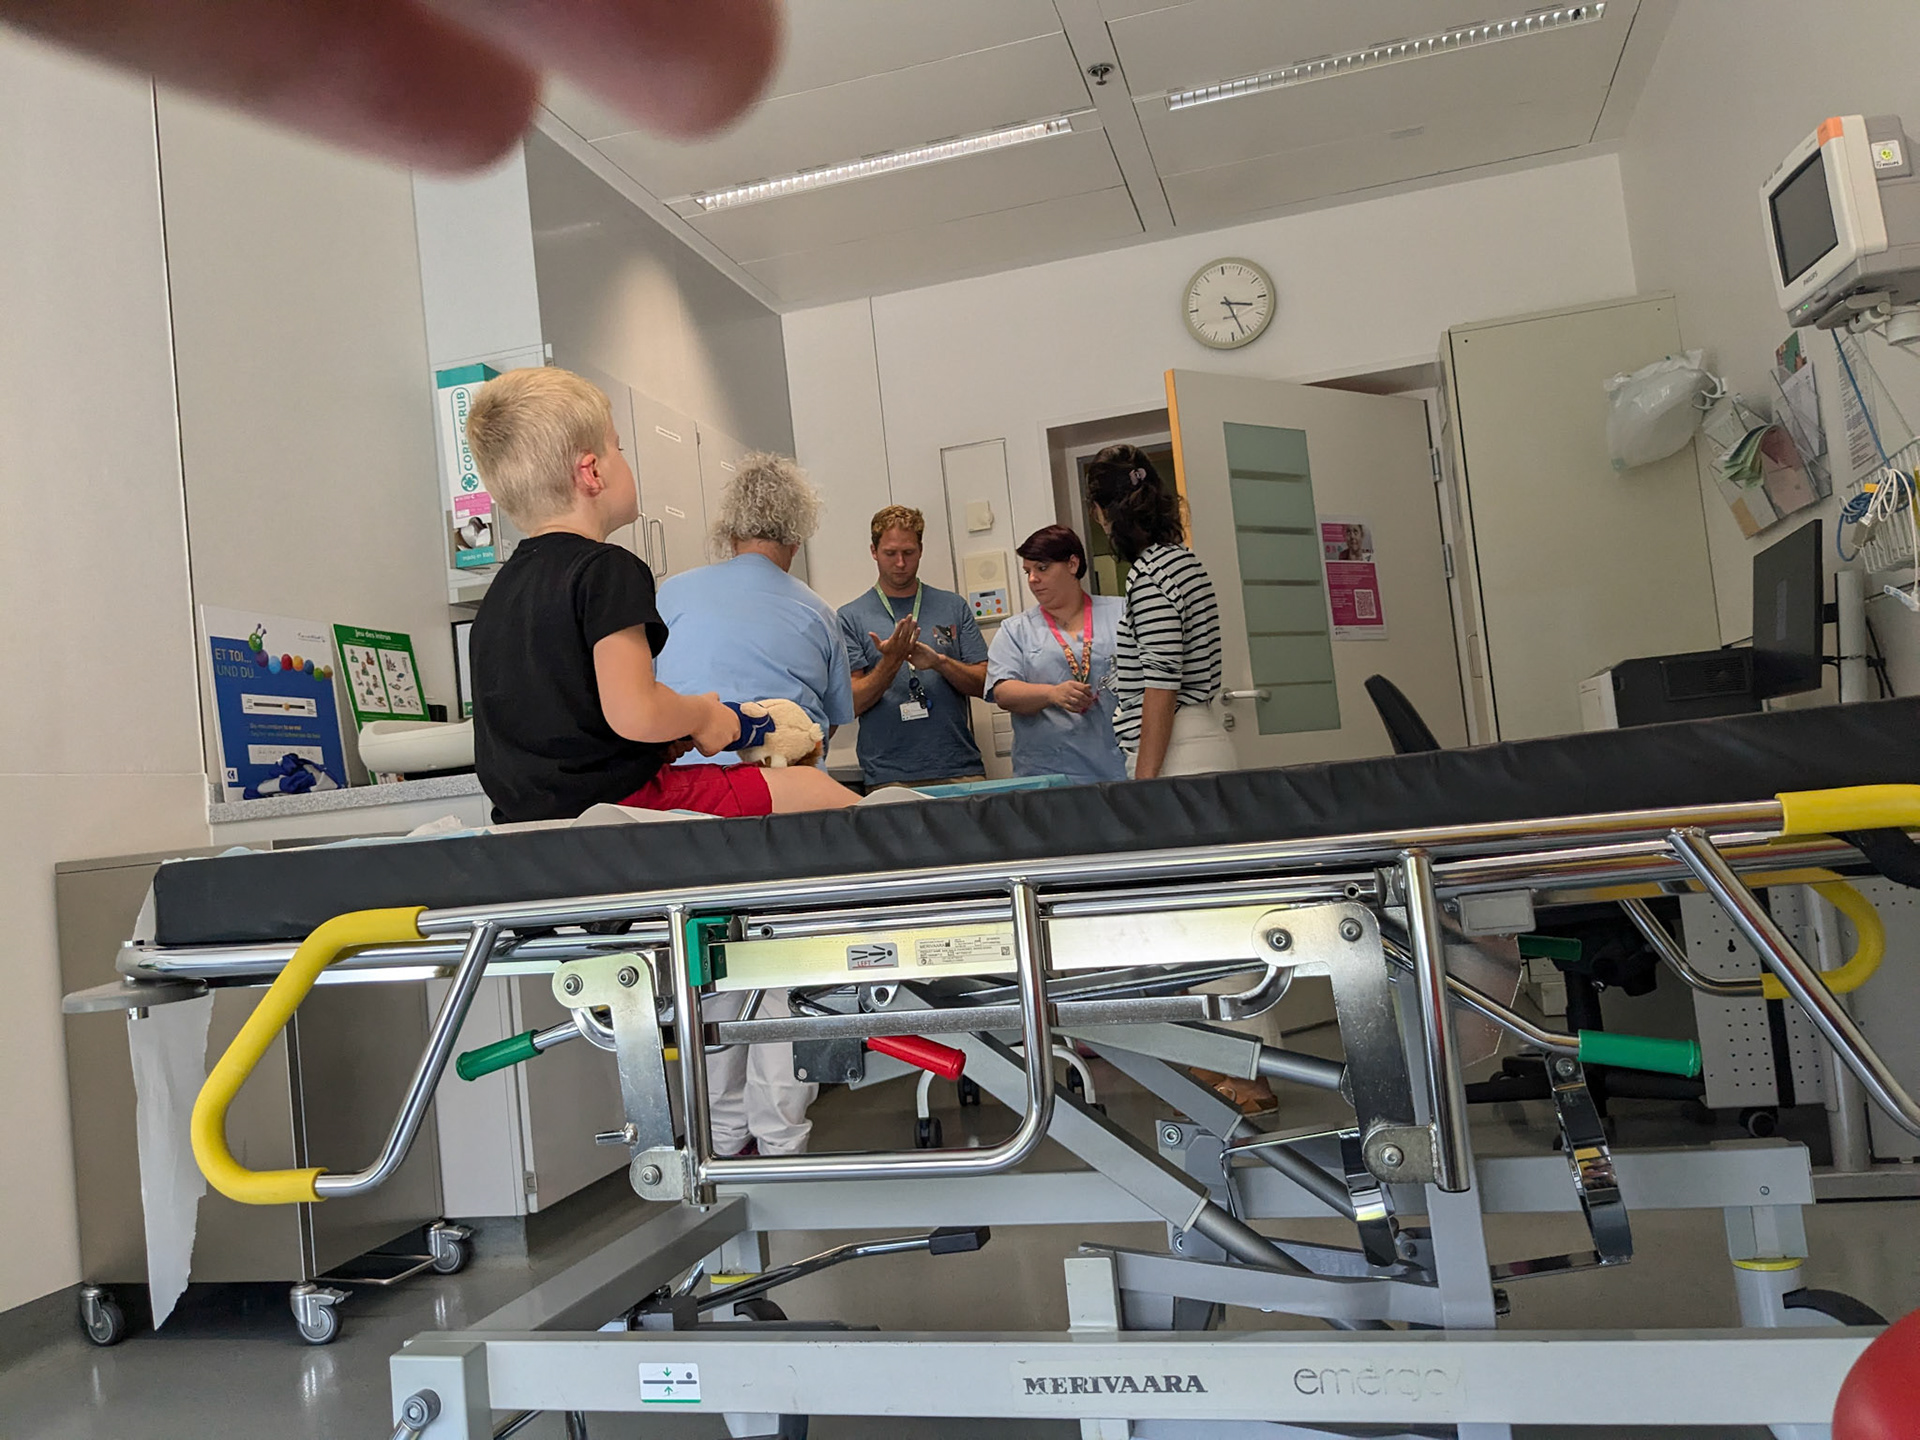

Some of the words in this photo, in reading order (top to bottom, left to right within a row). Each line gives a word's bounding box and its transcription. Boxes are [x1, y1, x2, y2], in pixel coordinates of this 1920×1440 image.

[456, 391, 467, 433] SCRUB
[461, 439, 473, 471] CORE
[355, 629, 365, 638] Jeu
[215, 648, 227, 660] ET
[216, 666, 239, 677] UND
[1023, 1375, 1208, 1395] MERIVAARA
[1294, 1368, 1447, 1401] emergo
